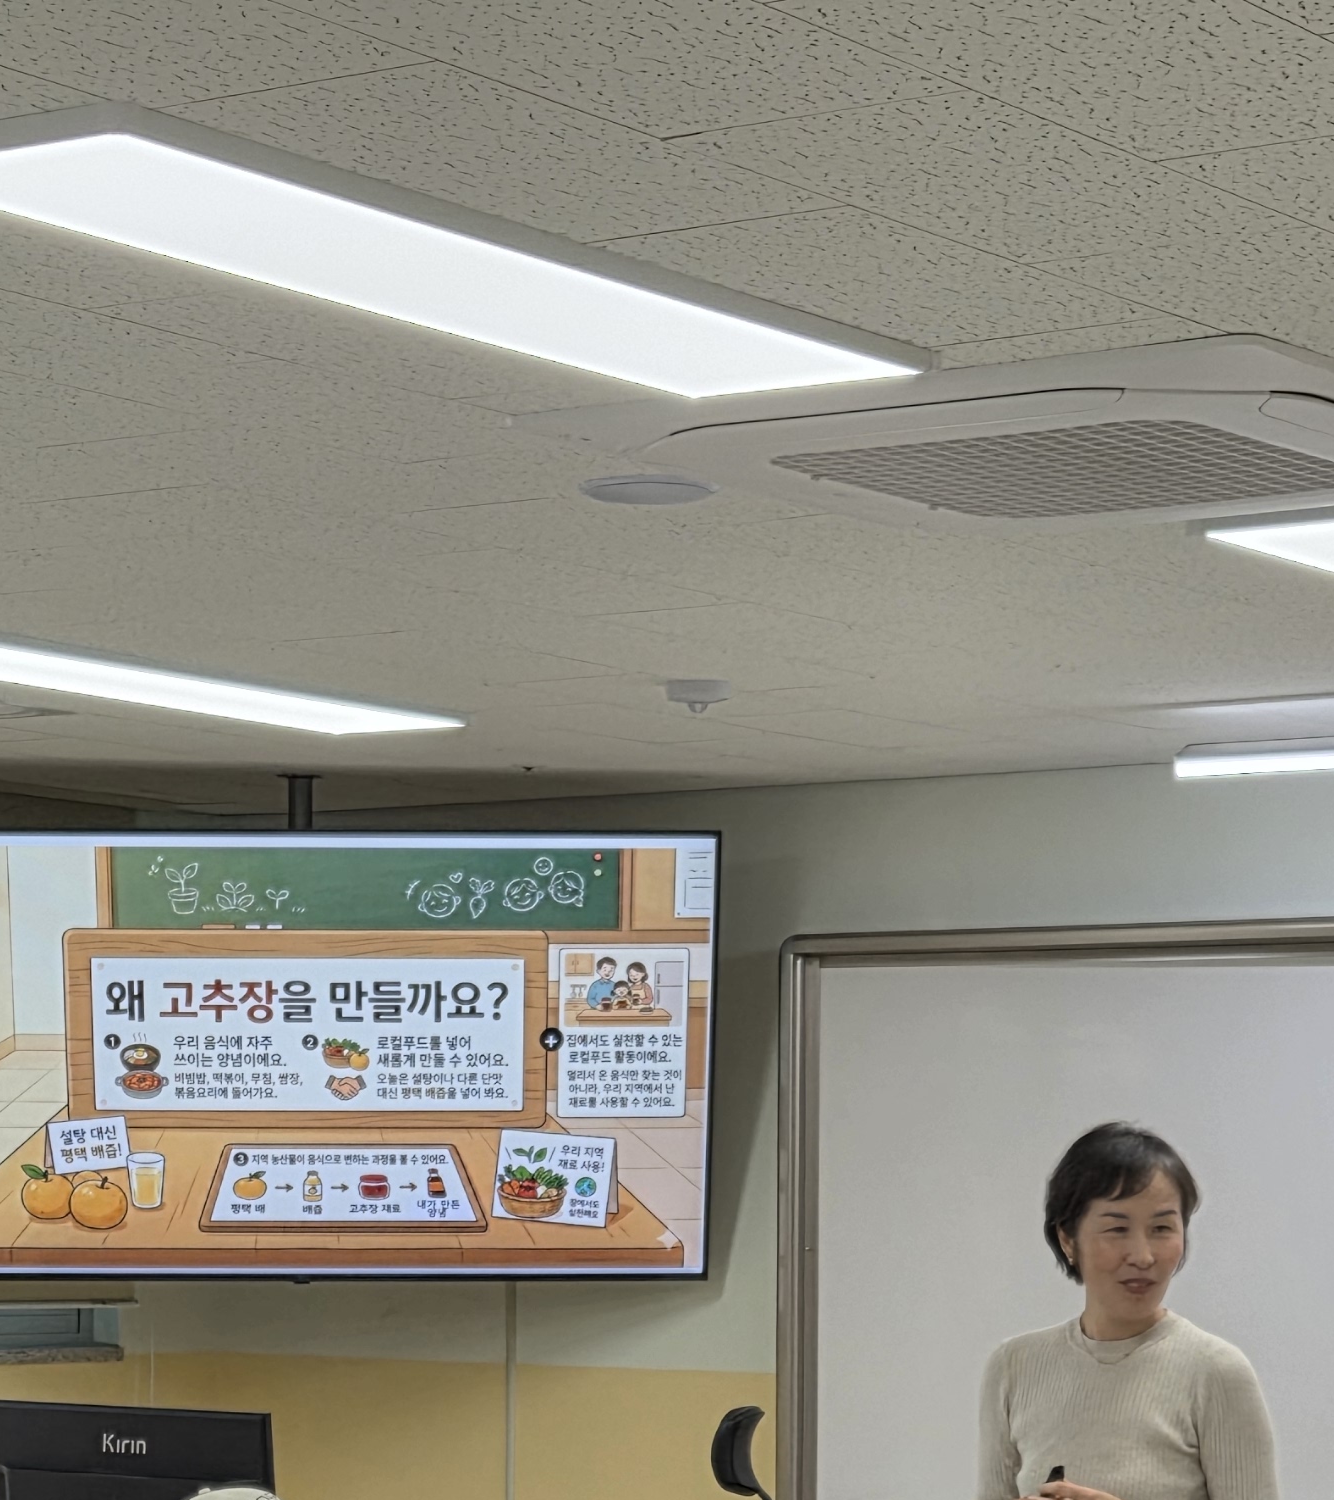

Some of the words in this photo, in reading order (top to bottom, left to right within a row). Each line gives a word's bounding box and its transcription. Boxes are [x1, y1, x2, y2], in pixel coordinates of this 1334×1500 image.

[106, 980, 145, 1023] 왜
[159, 980, 316, 1023] 고추장을
[329, 980, 509, 1023] 만들까요?
[173, 1036, 199, 1050] 우리
[203, 1036, 243, 1050] 음식에
[246, 1036, 273, 1050] 자주
[377, 1036, 442, 1050] 로컬푸드를
[446, 1036, 472, 1050] 넣어
[566, 1034, 609, 1048] 집에서도
[613, 1034, 645, 1048] 실천할
[648, 1034, 659, 1048] 수
[662, 1034, 683, 1048] 있는
[173, 1053, 213, 1068] 쓰이는
[217, 1053, 287, 1068] 양념이에요.
[376, 1053, 416, 1068] 새롭게
[420, 1053, 446, 1068] 만들
[449, 1053, 462, 1068] 수
[466, 1053, 509, 1068] 있어요.
[569, 1050, 612, 1064] 로컬푸드
[615, 1050, 672, 1064] 활동이에요.
[174, 1072, 210, 1086] 비빔밥,
[212, 1072, 248, 1086] 떡볶이,
[251, 1072, 276, 1086] 무침,
[278, 1072, 303, 1086] 쌈장,
[377, 1073, 409, 1086] 오늘은
[411, 1073, 454, 1086] 설탕이나
[457, 1073, 479, 1086] 다른
[481, 1073, 503, 1086] 단맛
[567, 1070, 595, 1081] 멀리서
[599, 1070, 607, 1081] 온
[611, 1070, 639, 1081] 음식만
[642, 1070, 660, 1081] 찾는
[663, 1070, 682, 1081] 것이
[174, 1086, 228, 1099] 볶음요리에
[232, 1086, 278, 1099] 들어가요.
[377, 1087, 398, 1100] 대신
[401, 1087, 422, 1100] 평택
[425, 1087, 457, 1100] 배즙을
[460, 1087, 481, 1100] 넣어
[484, 1087, 509, 1100] 봐요.
[569, 1084, 600, 1094] 아니라,
[603, 1084, 622, 1094] 우리
[625, 1084, 662, 1094] 지역에서
[665, 1084, 675, 1094] 난
[569, 1097, 596, 1108] 재료를
[599, 1097, 628, 1108] 사용할
[631, 1097, 641, 1108] 수
[643, 1097, 675, 1108] 있어요.
[60, 1128, 87, 1145] 설탕
[90, 1125, 117, 1141] 대신
[60, 1146, 87, 1164] 평택
[91, 1143, 122, 1159] 배즙!
[561, 1145, 581, 1157] 우리
[584, 1146, 604, 1159] 지역
[252, 1154, 269, 1165] 지역
[271, 1154, 305, 1165] 농산물이
[308, 1154, 342, 1165] 음식으로
[343, 1154, 369, 1165] 변하는
[372, 1154, 397, 1165] 과정을
[400, 1154, 408, 1165] 볼
[411, 1154, 419, 1165] 수
[421, 1154, 449, 1165] 있어요.
[558, 1159, 578, 1170] 재료
[581, 1160, 605, 1173] 사용!
[303, 1205, 323, 1215] 배즙
[349, 1204, 379, 1214] 고추장
[381, 1204, 401, 1214] 재료
[103, 1433, 147, 1455] Kirin
